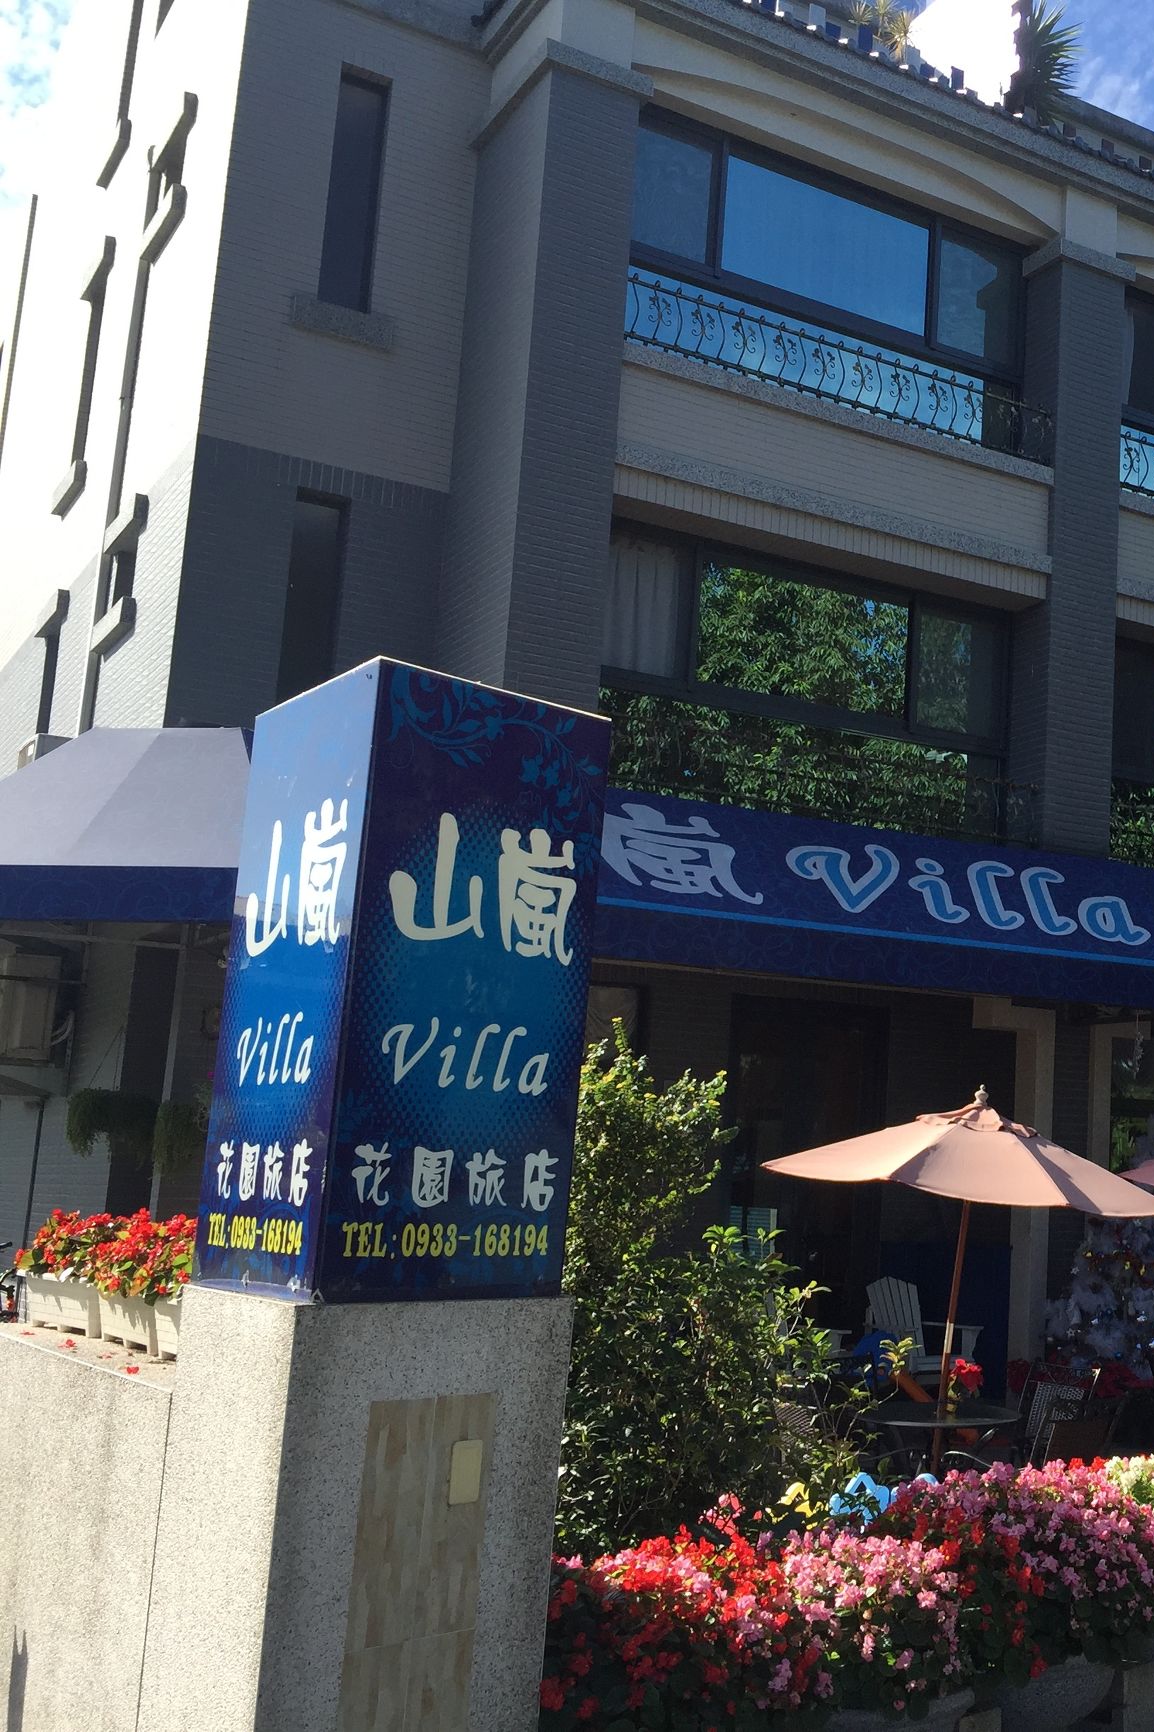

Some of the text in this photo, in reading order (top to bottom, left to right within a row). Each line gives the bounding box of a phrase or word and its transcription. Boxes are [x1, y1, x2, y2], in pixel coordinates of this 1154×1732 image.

[245, 797, 349, 958] 山嵐
[389, 812, 577, 966] 山嵐
[786, 844, 1151, 946] Villa
[237, 1011, 314, 1086] Villa
[382, 1017, 550, 1097] Villa
[217, 1138, 312, 1207] 花園旅店
[351, 1142, 559, 1213] 花園旅店
